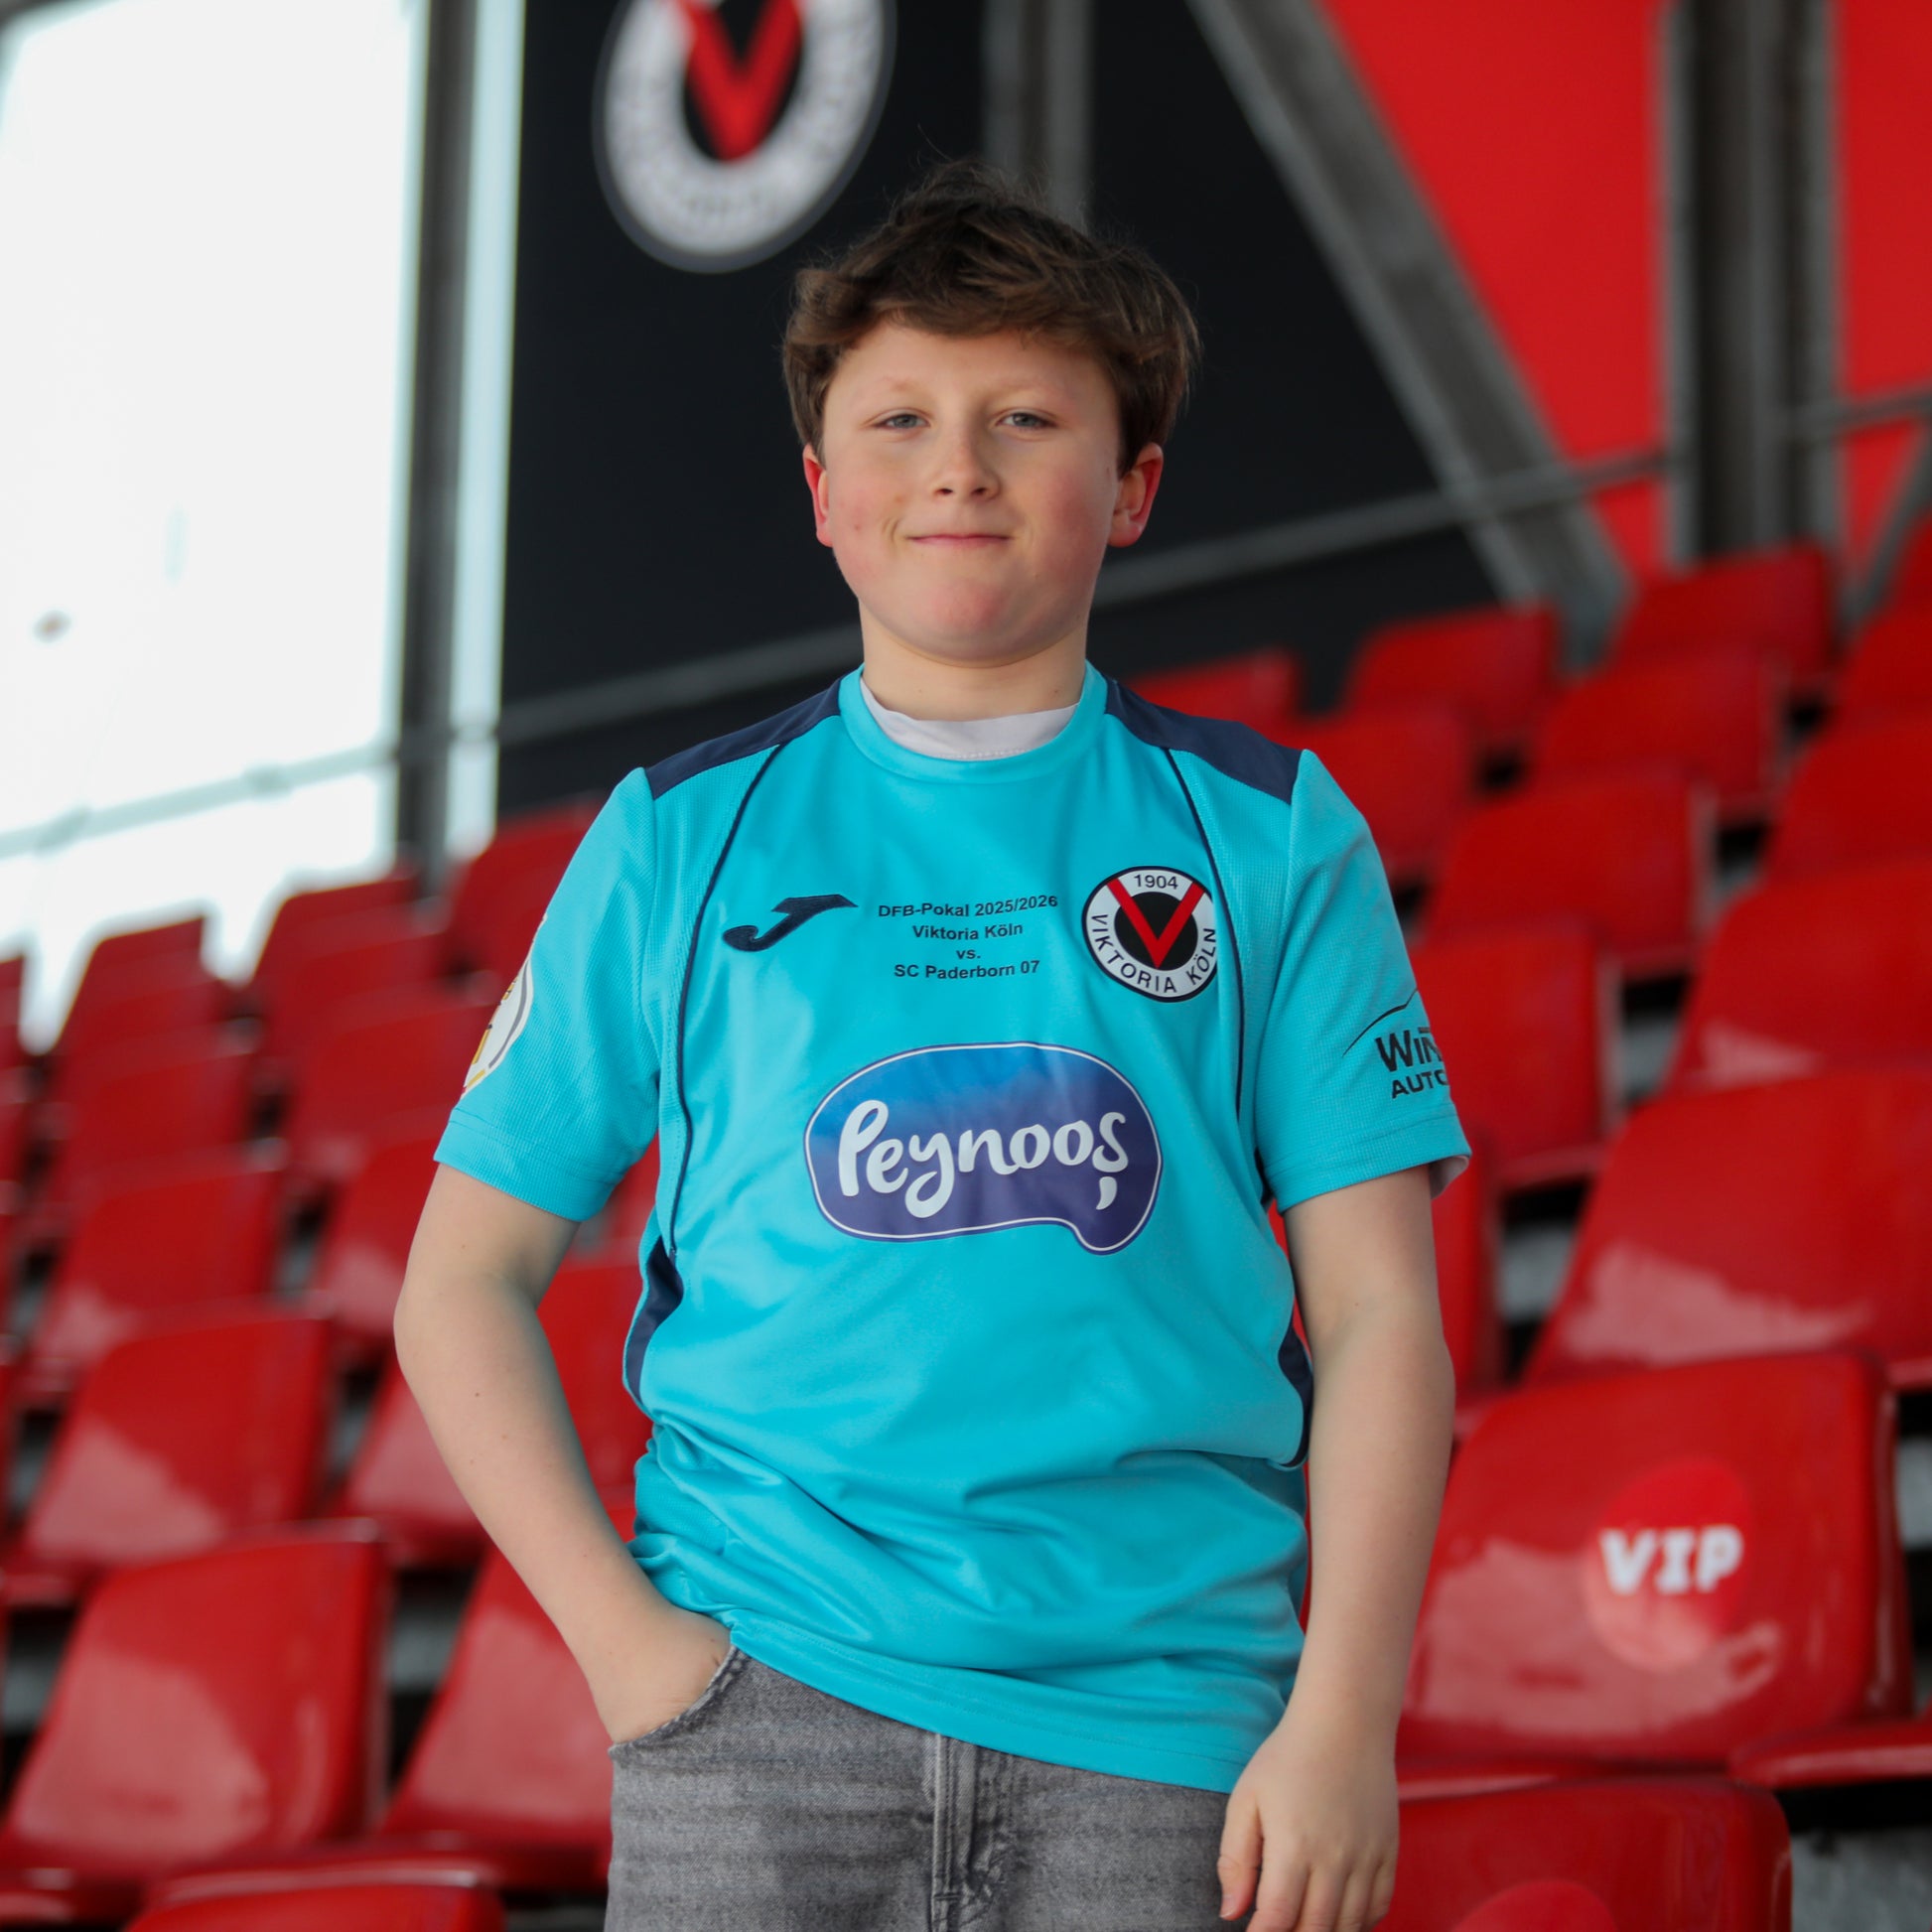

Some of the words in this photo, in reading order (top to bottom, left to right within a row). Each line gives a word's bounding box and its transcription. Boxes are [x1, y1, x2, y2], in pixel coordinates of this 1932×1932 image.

[1134, 874, 1178, 890] 1904
[879, 902, 969, 917] DFB-Pokal
[975, 895, 1058, 916] 2025/2026
[912, 925, 979, 940] Viktoria
[985, 923, 1023, 938] Köln
[956, 949, 981, 960] vs.
[1091, 914, 1177, 993] VIKTORIA
[1185, 927, 1217, 985] KÖLN
[895, 964, 919, 977] SC
[925, 965, 1015, 979] Paderborn
[1021, 960, 1040, 974] 07
[1598, 1524, 1744, 1595] VIP
